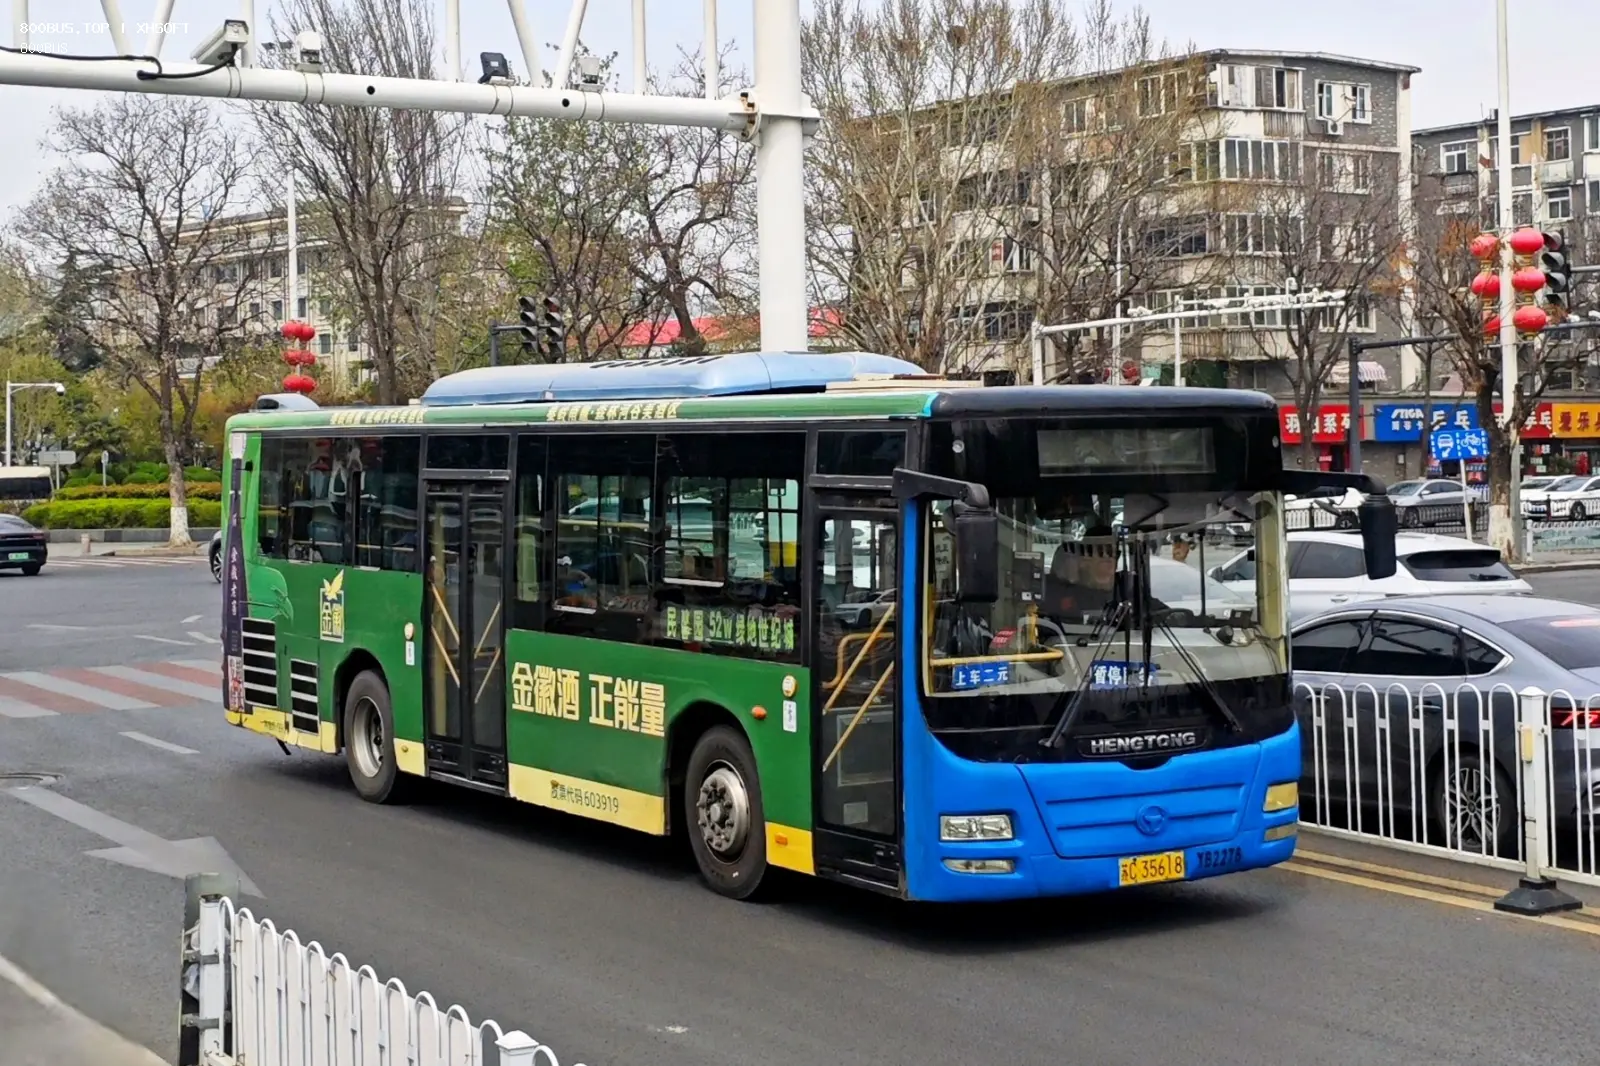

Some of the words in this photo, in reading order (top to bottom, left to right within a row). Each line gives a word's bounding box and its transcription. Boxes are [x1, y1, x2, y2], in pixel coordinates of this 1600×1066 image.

[955, 665, 1009, 687] 上车二元
[511, 661, 581, 722] 金徽酒
[588, 673, 666, 738] 正能量
[1090, 731, 1196, 754] HENGTONG
